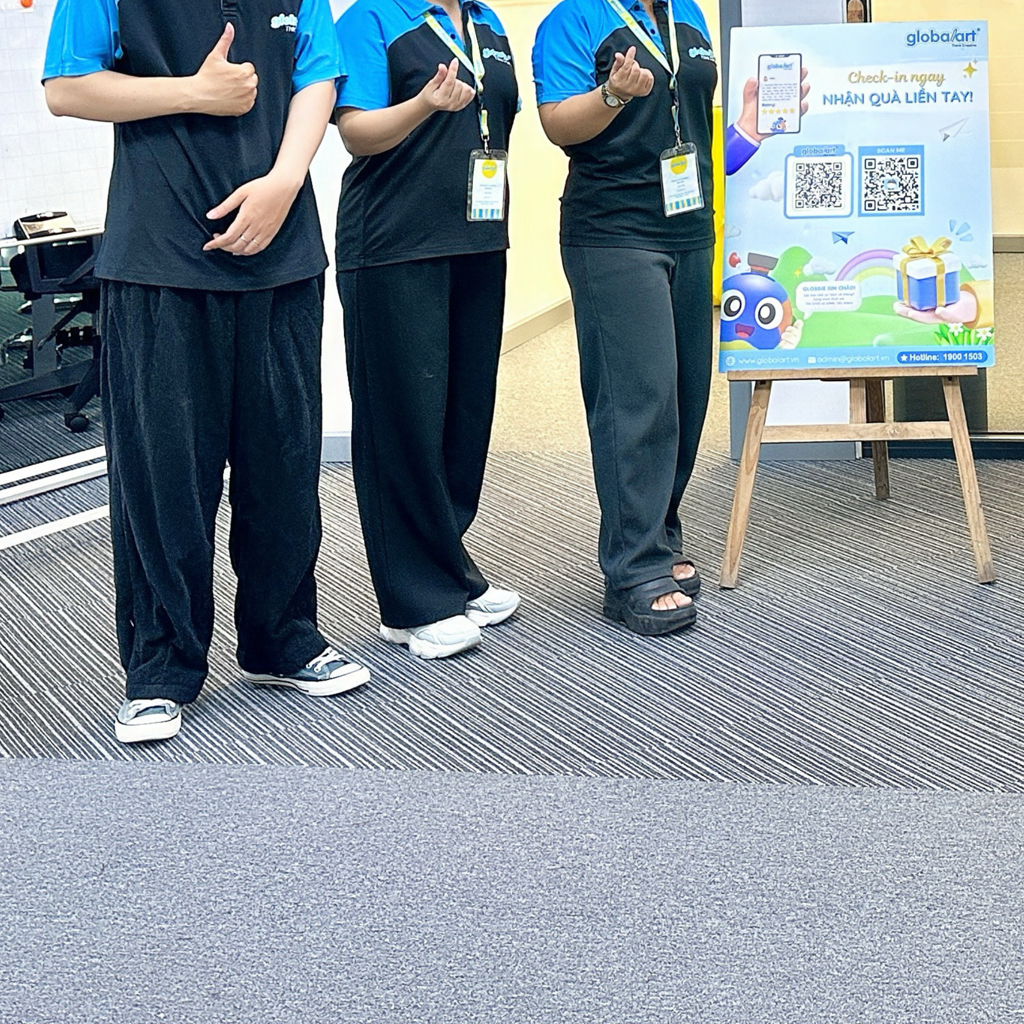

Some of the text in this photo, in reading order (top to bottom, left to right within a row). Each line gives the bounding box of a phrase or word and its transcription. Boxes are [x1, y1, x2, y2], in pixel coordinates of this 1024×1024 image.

[848, 71, 945, 87] Check-in ngay
[823, 87, 974, 107] NHẬN QUÀ LIỀN TAY!
[738, 356, 799, 365] www.globalart.vn
[817, 354, 890, 364] admin@globalart.vn
[909, 352, 983, 362] Hotline: 1900 1503
